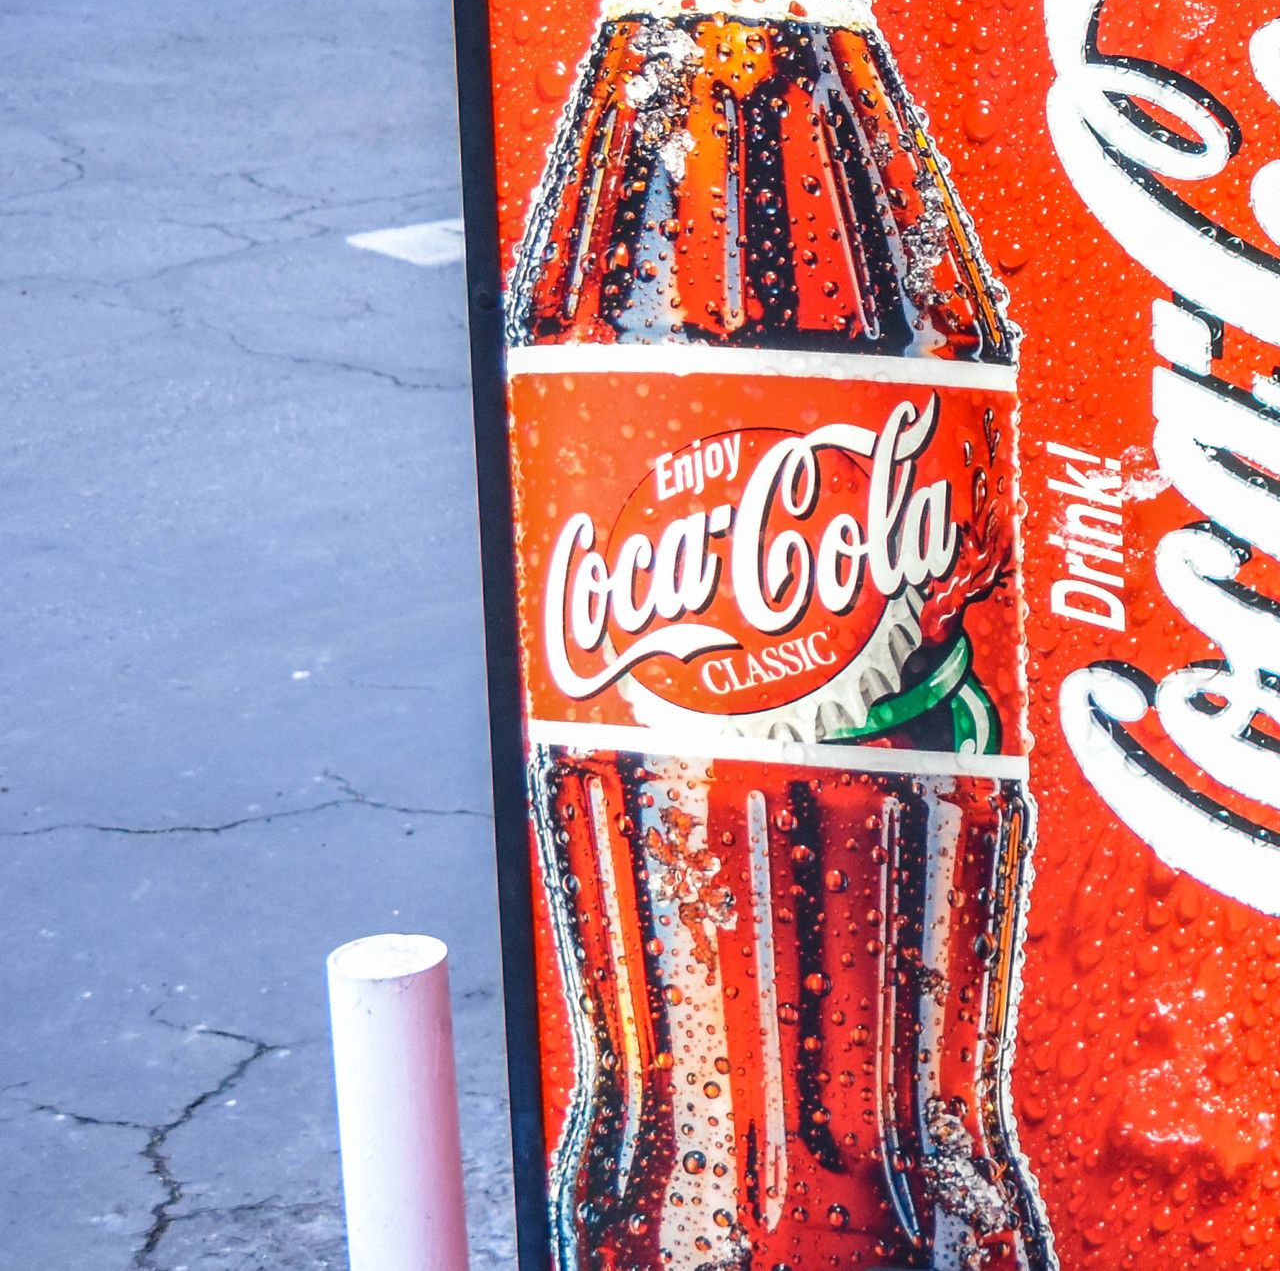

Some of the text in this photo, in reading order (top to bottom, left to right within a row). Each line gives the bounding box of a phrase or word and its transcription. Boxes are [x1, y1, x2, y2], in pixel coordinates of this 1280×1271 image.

[654, 433, 742, 502] Enjoy
[545, 389, 958, 700] Coca-Cola
[1046, 442, 1127, 632] Drink!
[701, 632, 838, 695] CLASSIC
